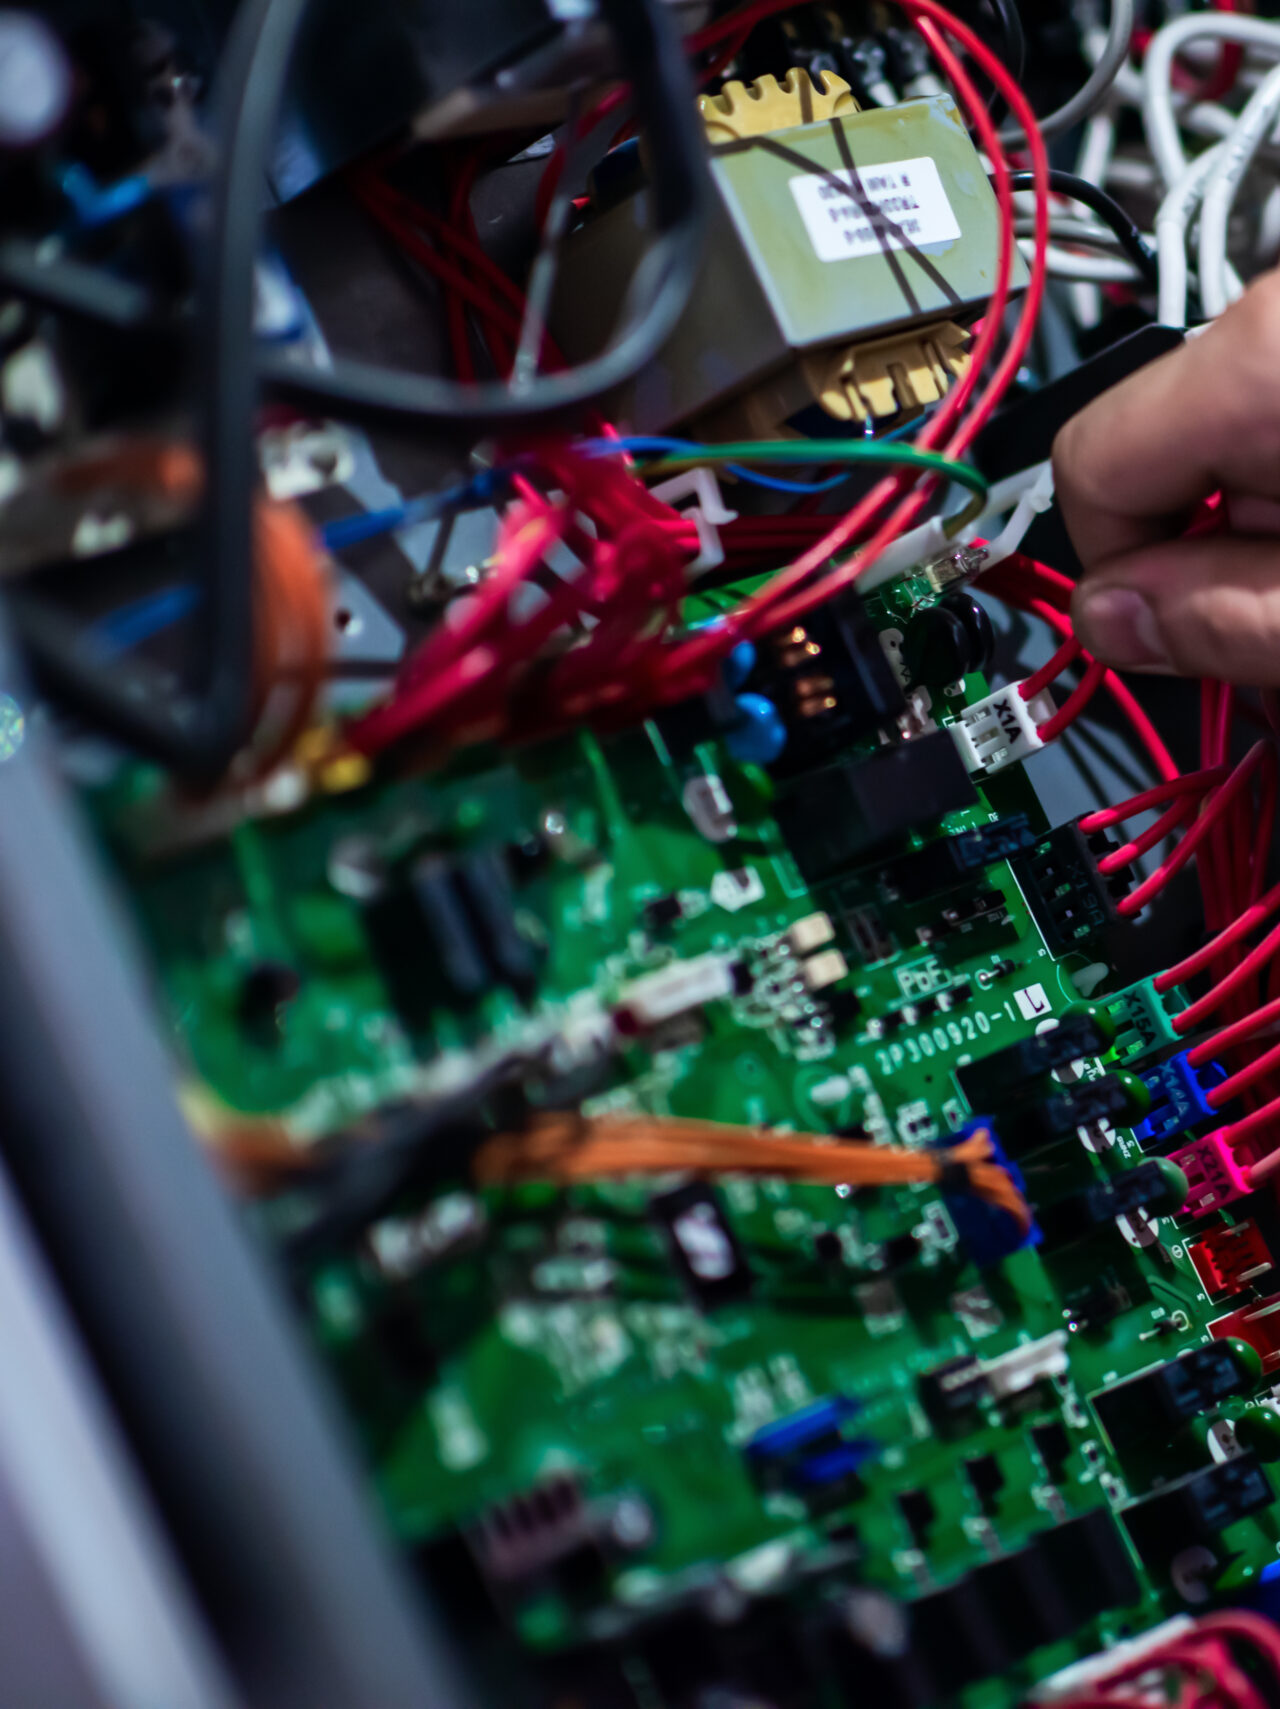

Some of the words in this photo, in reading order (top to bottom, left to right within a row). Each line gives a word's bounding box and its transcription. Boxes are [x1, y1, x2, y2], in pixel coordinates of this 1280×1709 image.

[993, 699, 1022, 744] X1A
[1065, 860, 1105, 927] X19A
[875, 1000, 1016, 1075] 2P300920-1
[1123, 990, 1156, 1046] X15A
[1158, 1060, 1190, 1117] X14A
[1197, 1145, 1231, 1199] X21A
